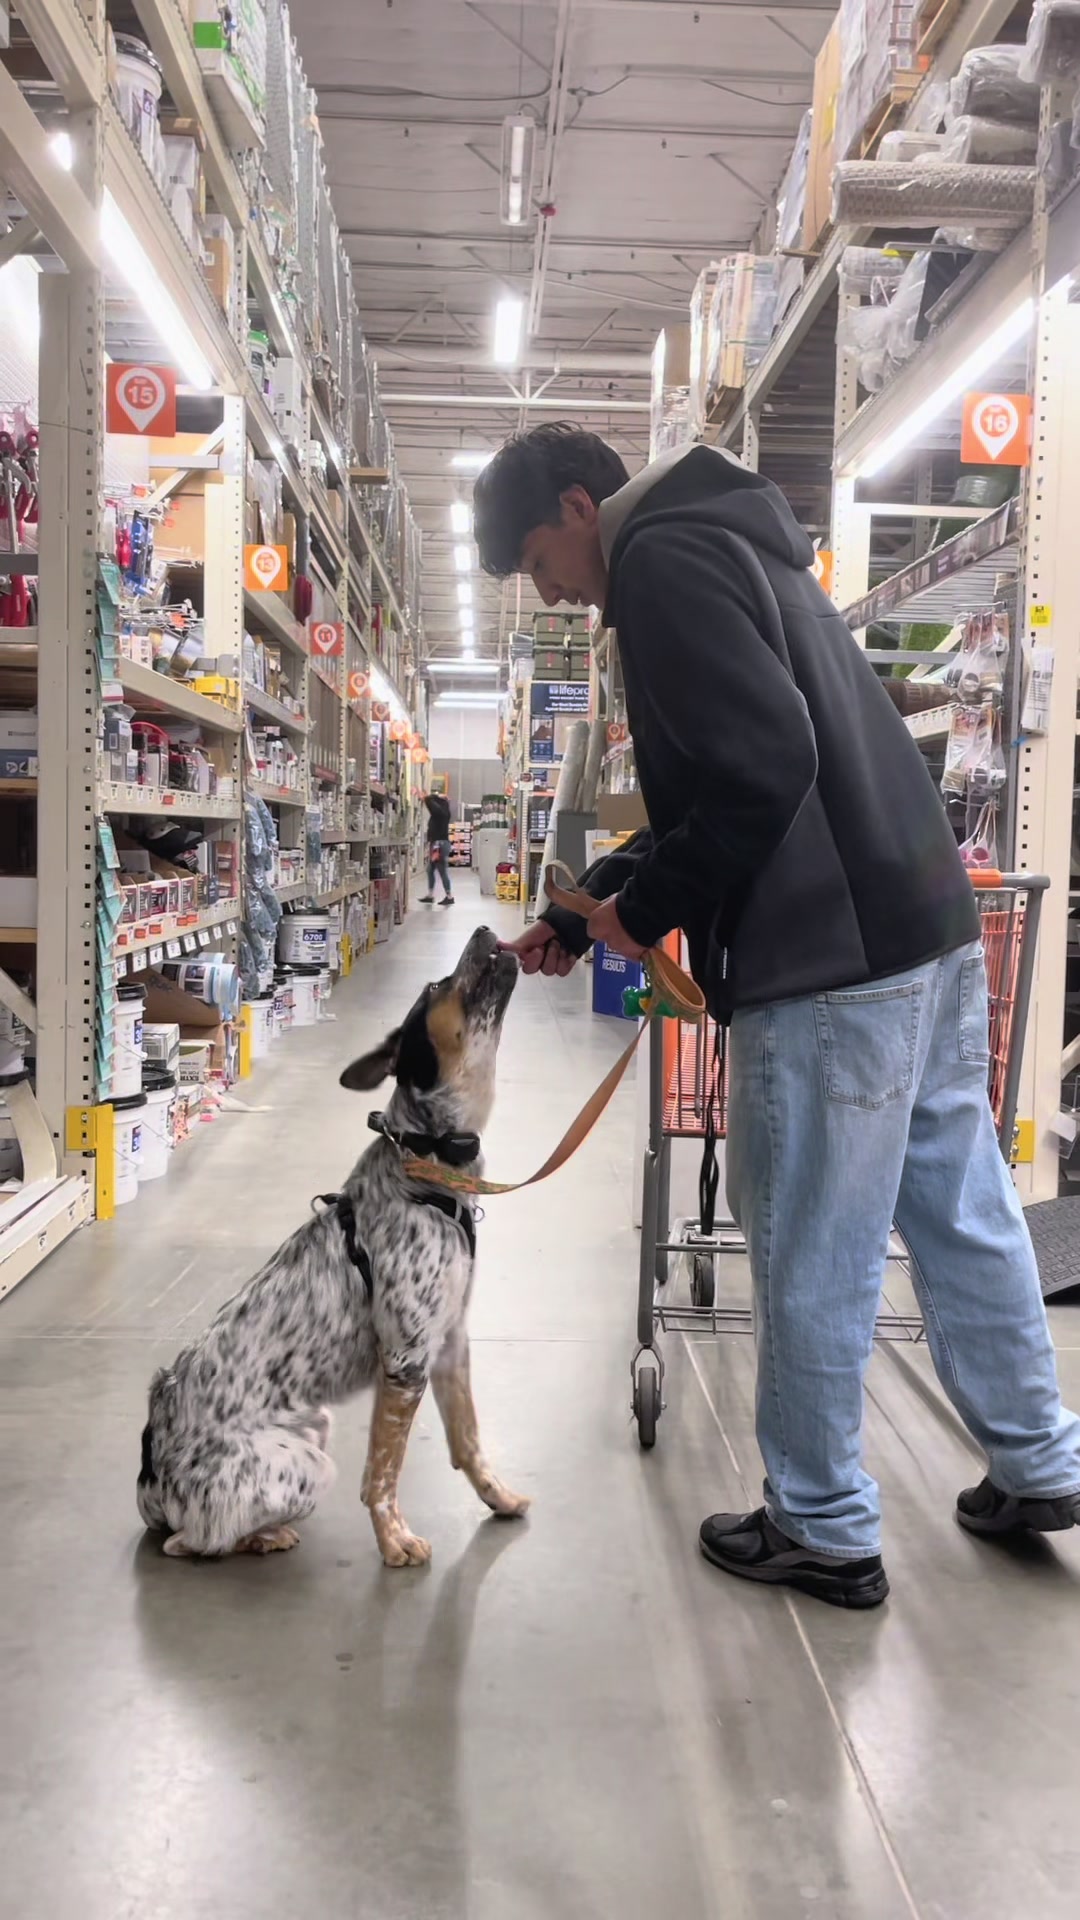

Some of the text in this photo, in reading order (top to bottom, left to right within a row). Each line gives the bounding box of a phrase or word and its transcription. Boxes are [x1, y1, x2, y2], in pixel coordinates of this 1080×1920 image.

[128, 386, 154, 405] 15
[983, 414, 1009, 432] 16
[257, 558, 275, 571] 13
[303, 933, 323, 941] 6700
[602, 957, 627, 973] RESULTS
